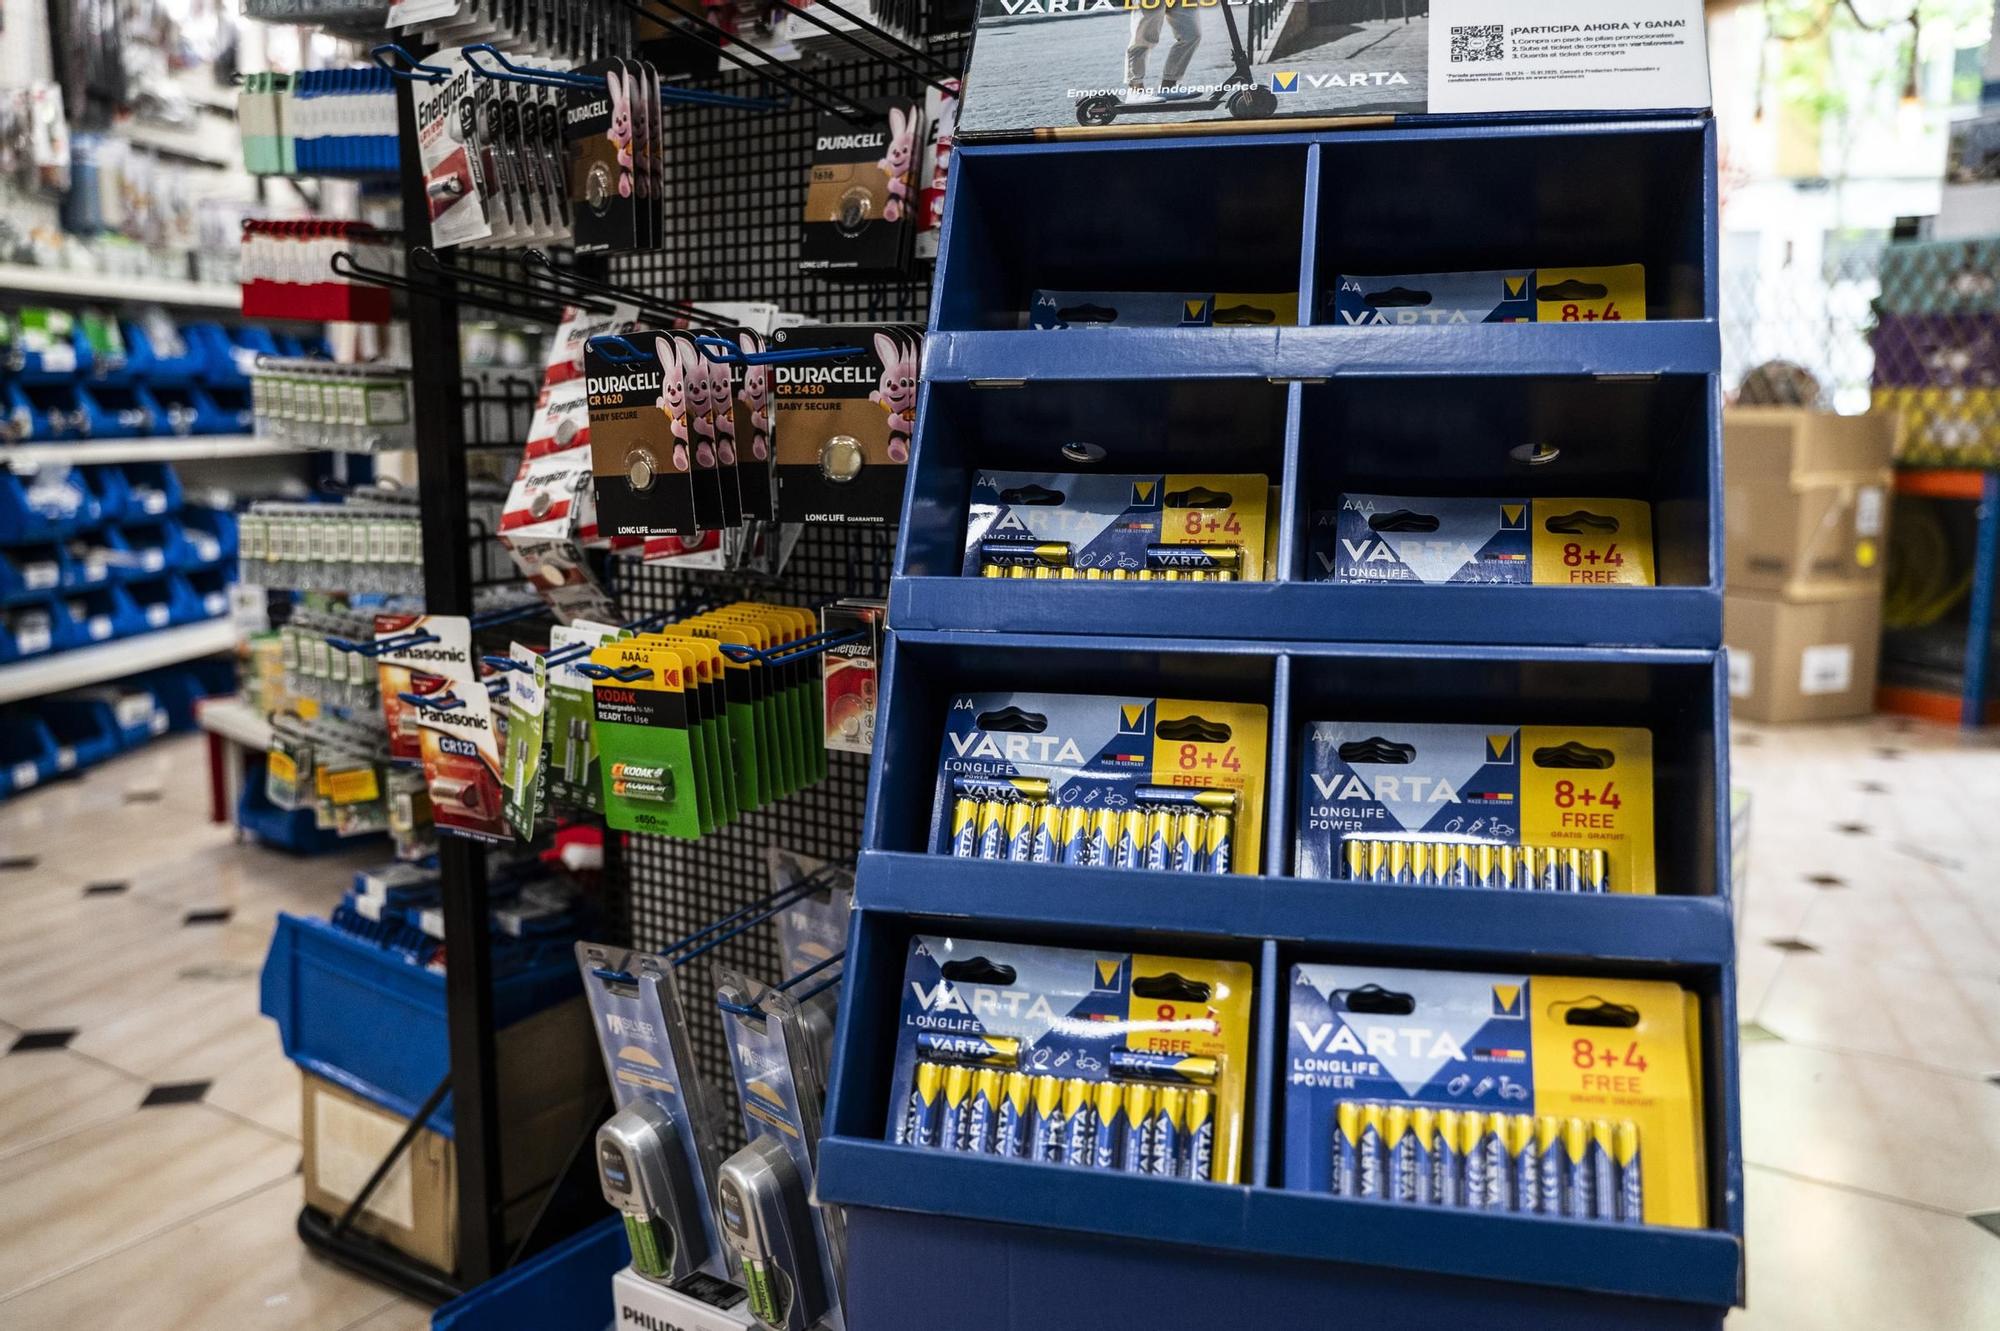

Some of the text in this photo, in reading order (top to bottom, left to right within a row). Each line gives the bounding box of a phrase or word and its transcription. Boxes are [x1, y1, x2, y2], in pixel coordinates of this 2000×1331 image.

[1511, 19, 1686, 36] ¡PARTICIPA AHORA Y GANA!
[1306, 71, 1409, 88] VARTA
[1066, 81, 1259, 99] Empowering Independence
[419, 69, 470, 131] Energizer
[567, 99, 609, 125] DURACELL
[817, 133, 884, 151] DURACELL
[1341, 281, 1362, 292] AA
[1037, 296, 1057, 307] AA
[1341, 309, 1470, 324] VARTA
[1562, 303, 1622, 322] 8+4
[588, 372, 661, 395] DURACELL
[775, 366, 877, 384] DURACELL
[776, 385, 825, 394] CR 2430
[589, 393, 623, 406] CR 1620
[777, 402, 842, 411] BABY SECURE
[591, 410, 638, 422] BABY SECURE
[977, 476, 998, 487] AA
[1343, 499, 1375, 511] AAA
[805, 513, 827, 522] LONG
[828, 514, 845, 522] LIFE
[970, 508, 1098, 531] ARTA
[1184, 511, 1242, 536] 8+4
[618, 526, 636, 535] LONG
[636, 526, 649, 534] LIFE
[1341, 538, 1479, 564] VARTA
[1563, 542, 1624, 568] 8+4
[1158, 555, 1213, 566] VARTA
[1340, 567, 1409, 578] LONGLIFE
[1570, 570, 1617, 583] FREE
[596, 689, 636, 704] KODAK
[953, 698, 974, 710] AA
[598, 703, 636, 714] Rechargeable
[598, 711, 649, 724] READY To Use
[420, 706, 490, 731] Panasonic
[1312, 730, 1346, 741] AAA
[440, 738, 478, 756] CR123
[949, 732, 1086, 764] VARTA
[1178, 743, 1241, 772] 8+4
[623, 766, 654, 778] KODAK
[944, 761, 1014, 774] LONGLIFE
[1172, 775, 1213, 785] FREE
[1311, 774, 1462, 804] VARTA
[964, 785, 1020, 798] VARTA
[1554, 779, 1622, 810] 8+4
[1310, 806, 1385, 819] LONGLIFE
[1561, 813, 1615, 829] FREE
[1310, 820, 1363, 831] POWER
[960, 827, 973, 857] RTA
[984, 828, 998, 859] RTA
[1551, 831, 1625, 841] GRATIS GRATUIT
[1016, 831, 1030, 861] RTA
[1033, 831, 1046, 862] RTA
[1118, 836, 1129, 868] RTA
[1149, 837, 1161, 870] RTA
[1175, 841, 1185, 871] RTA
[911, 981, 1058, 1021] VARTA
[906, 1014, 981, 1032] LONGLIFE
[929, 1037, 990, 1055] VARTA
[1149, 1038, 1191, 1050] FREE
[1295, 1021, 1466, 1062] VARTA
[1572, 1038, 1648, 1072] 8+4
[1293, 1058, 1379, 1076] LONGLIFE
[1293, 1073, 1355, 1088] POWER
[1581, 1074, 1642, 1093] FREE
[956, 1099, 969, 1151] ARTA
[969, 1098, 985, 1151] ARTA
[995, 1100, 1010, 1155] ARTA
[1070, 1110, 1087, 1165] ARTA
[1139, 1118, 1152, 1173] ARTA
[1152, 1116, 1168, 1174] ARTA
[1197, 1122, 1212, 1179] ARTA
[1362, 1131, 1375, 1195] VARTA
[622, 1305, 685, 1331] PHILIP
